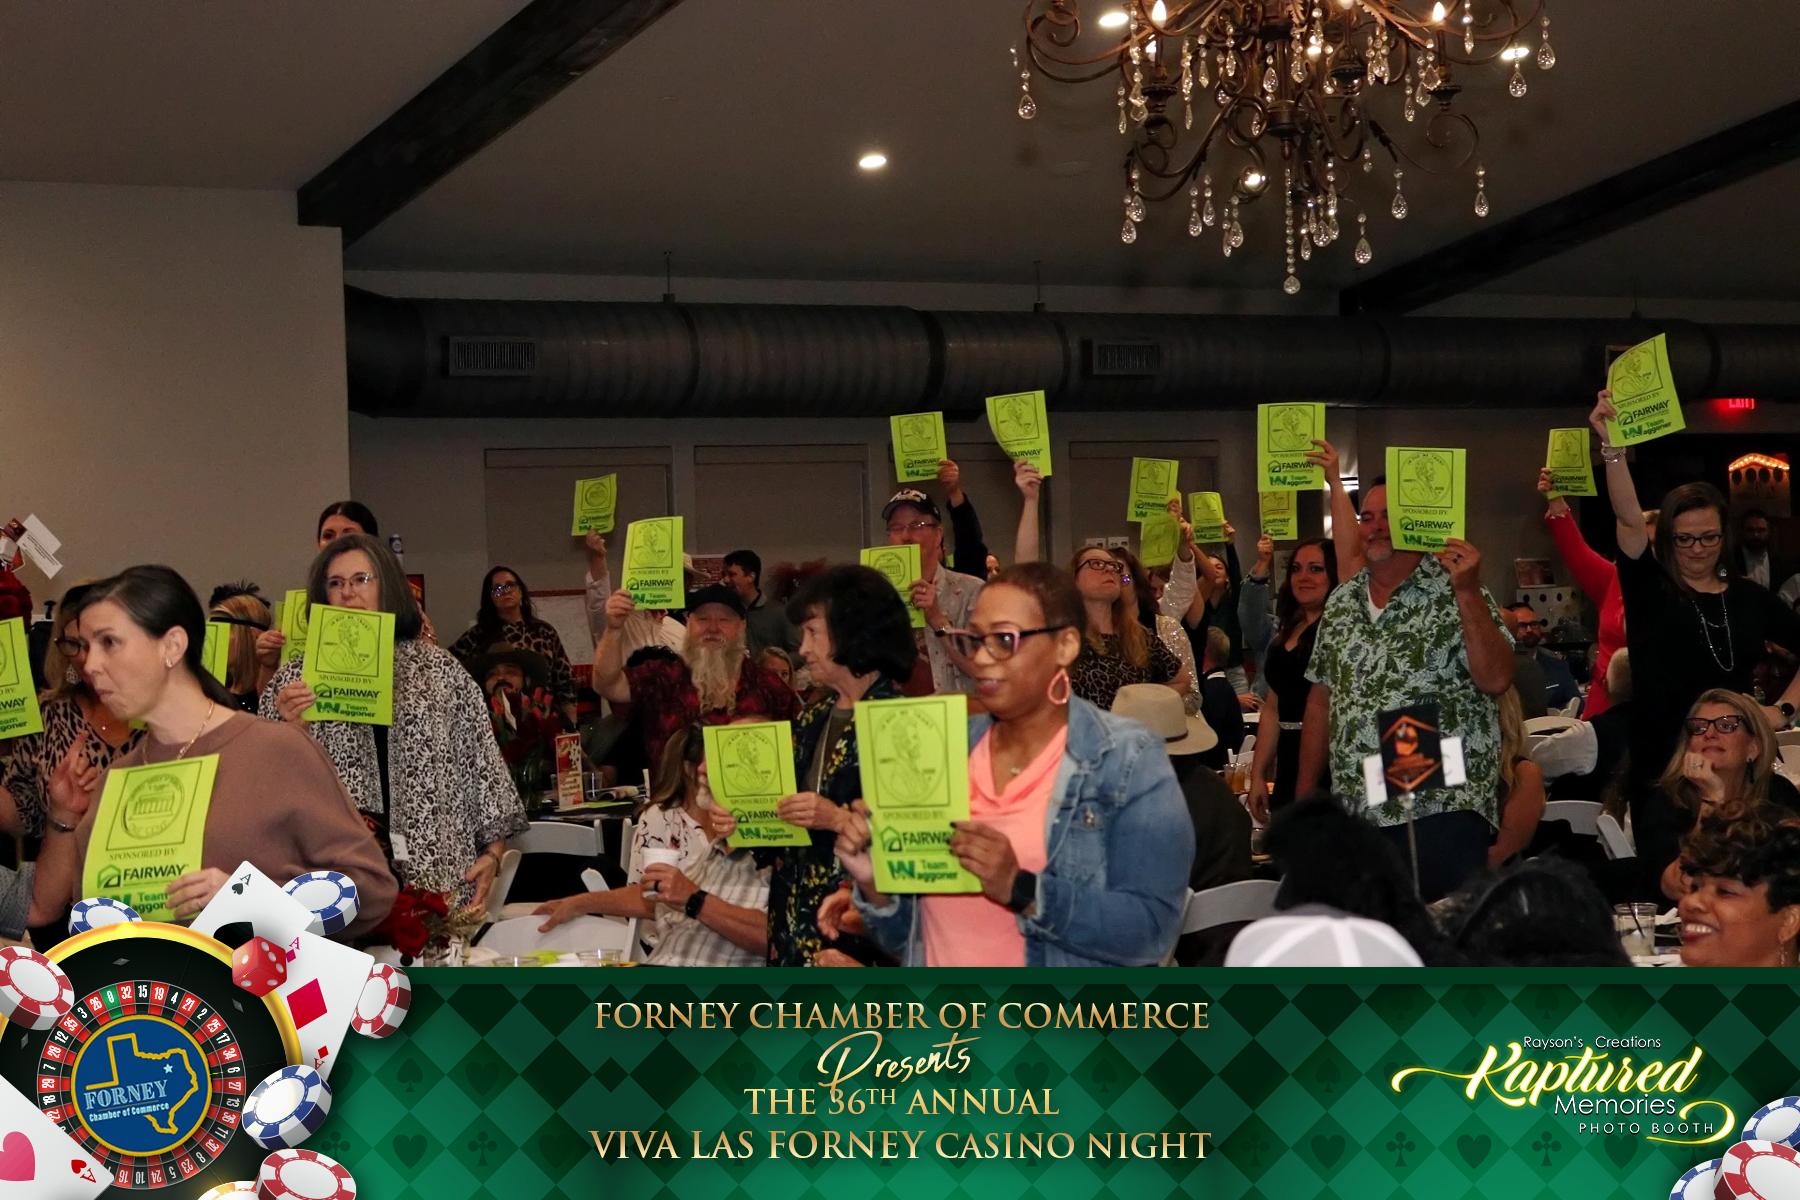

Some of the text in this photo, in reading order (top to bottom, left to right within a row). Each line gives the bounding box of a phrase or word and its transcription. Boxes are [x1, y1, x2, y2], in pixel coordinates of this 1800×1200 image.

[1633, 400, 1669, 418] FAIRWAY
[1414, 520, 1454, 529] FAIRWAY
[640, 579, 674, 587] FAIRWAY
[333, 687, 380, 698] FAIRWAY
[345, 703, 368, 711] Team
[109, 848, 162, 860] SPONSORED
[123, 863, 186, 880] FAIRWAY
